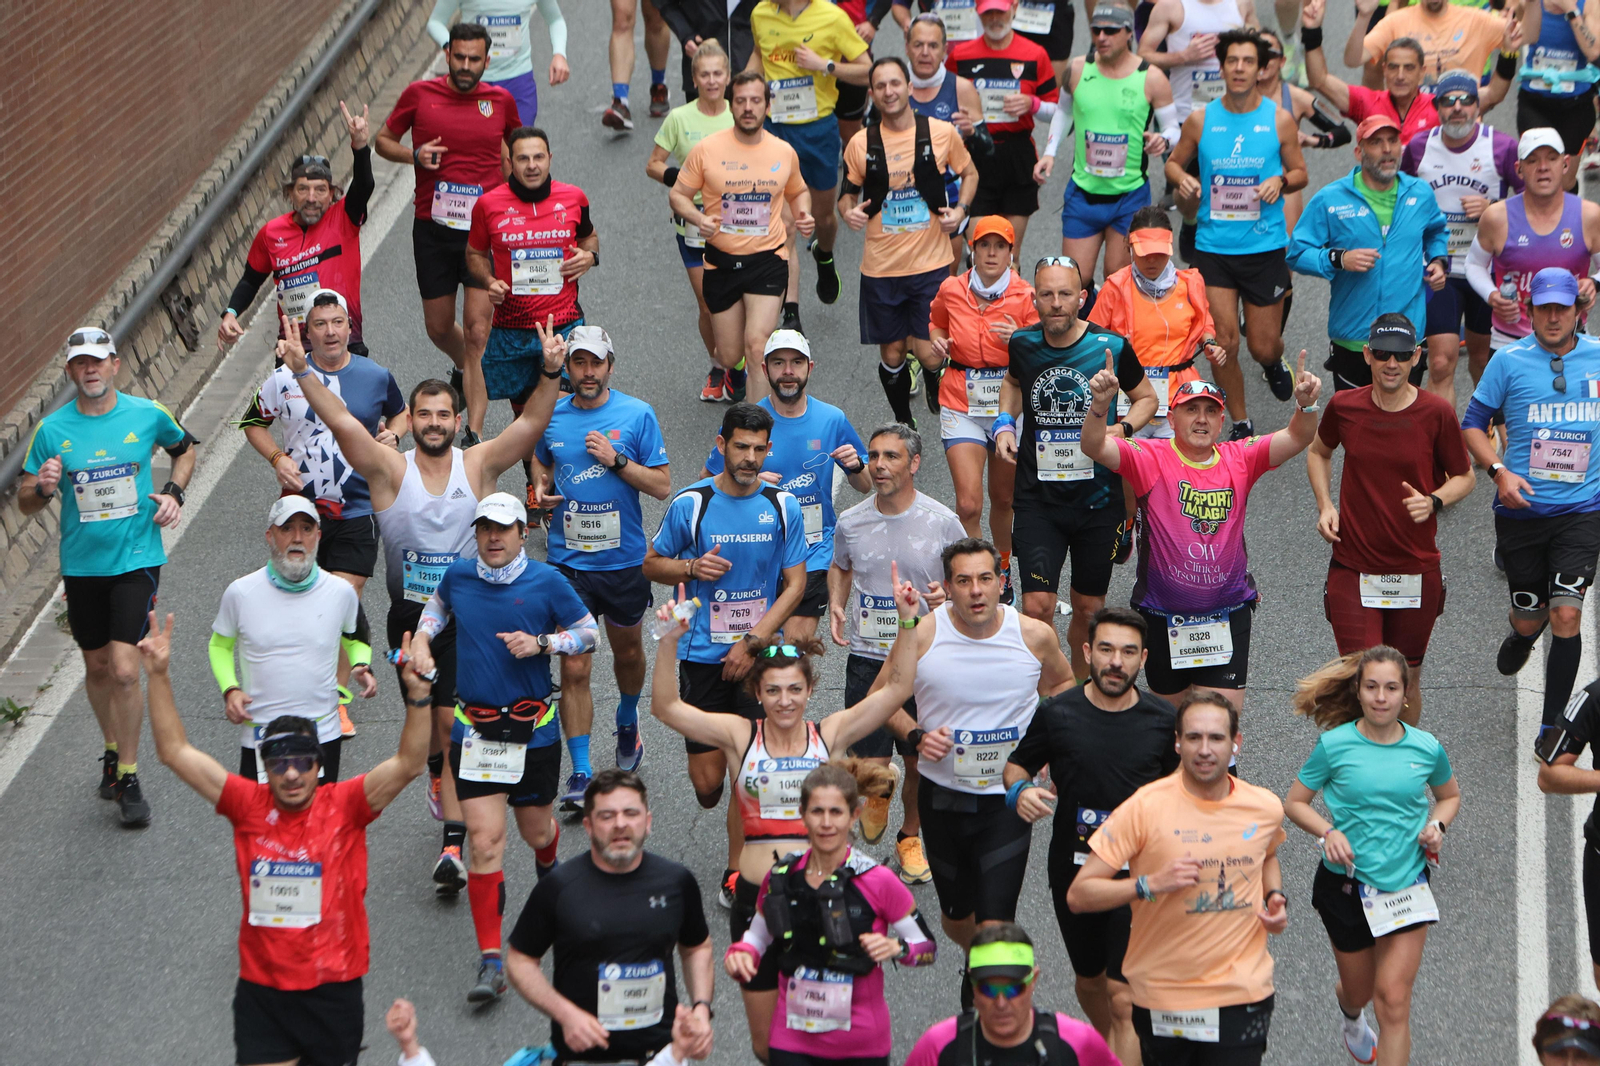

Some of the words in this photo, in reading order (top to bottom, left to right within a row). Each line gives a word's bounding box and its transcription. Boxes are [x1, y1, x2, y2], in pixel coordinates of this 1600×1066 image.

[492, 15, 516, 25] ZURICH
[782, 78, 808, 88] ZURICH
[1098, 134, 1124, 143] ZURICH
[725, 179, 752, 187] Maratón
[1430, 174, 1488, 194] ILÍPIDES
[450, 186, 478, 195] ZURICH
[895, 190, 920, 200] ZURICH
[449, 200, 466, 208] 7124
[446, 212, 466, 220] BAENA
[502, 230, 524, 242] Los
[528, 228, 571, 240] Lentos
[530, 250, 558, 258] ZURICH
[276, 258, 290, 268] Los
[530, 265, 548, 274] 8485
[286, 275, 313, 288] ZURICH
[290, 292, 306, 302] 9766
[984, 370, 1008, 378] ZURIC
[982, 386, 1000, 394] 1042
[1033, 377, 1046, 408] TIRADA
[1044, 368, 1072, 378] LARGA
[1034, 416, 1062, 424] TIRADA
[1054, 431, 1080, 440] ZURIC
[1554, 431, 1586, 441] ZURICH
[1054, 448, 1074, 457] 9951
[1552, 448, 1572, 458] 7547
[1546, 462, 1574, 470] ANTOINE
[92, 468, 126, 480] ZURICH
[572, 464, 605, 484] STRESS
[782, 473, 814, 492] STRESS
[94, 486, 115, 497] 9005
[797, 495, 816, 504] RICH
[581, 502, 612, 512] ZURICH
[581, 520, 601, 529] 9516
[710, 534, 772, 544] TROTASIERRA
[420, 556, 454, 564] ZURICH
[418, 571, 441, 582] 12181
[1380, 574, 1401, 583] 8862
[731, 590, 761, 600] ZURICH
[730, 608, 750, 618] 7679
[877, 616, 897, 625] 9102
[729, 622, 753, 630] MIGUEL
[1189, 632, 1210, 642] 8328
[1180, 645, 1224, 655] ESCAÑOSTYLE
[977, 731, 1012, 742] ZURICH
[976, 752, 999, 761] 8222
[781, 758, 820, 769] ZURICH
[779, 780, 802, 790] 1040
[780, 796, 802, 804] SAMU
[273, 863, 315, 876] ZURICH
[625, 962, 659, 978] ZURICH
[1186, 1016, 1206, 1025] LARA
